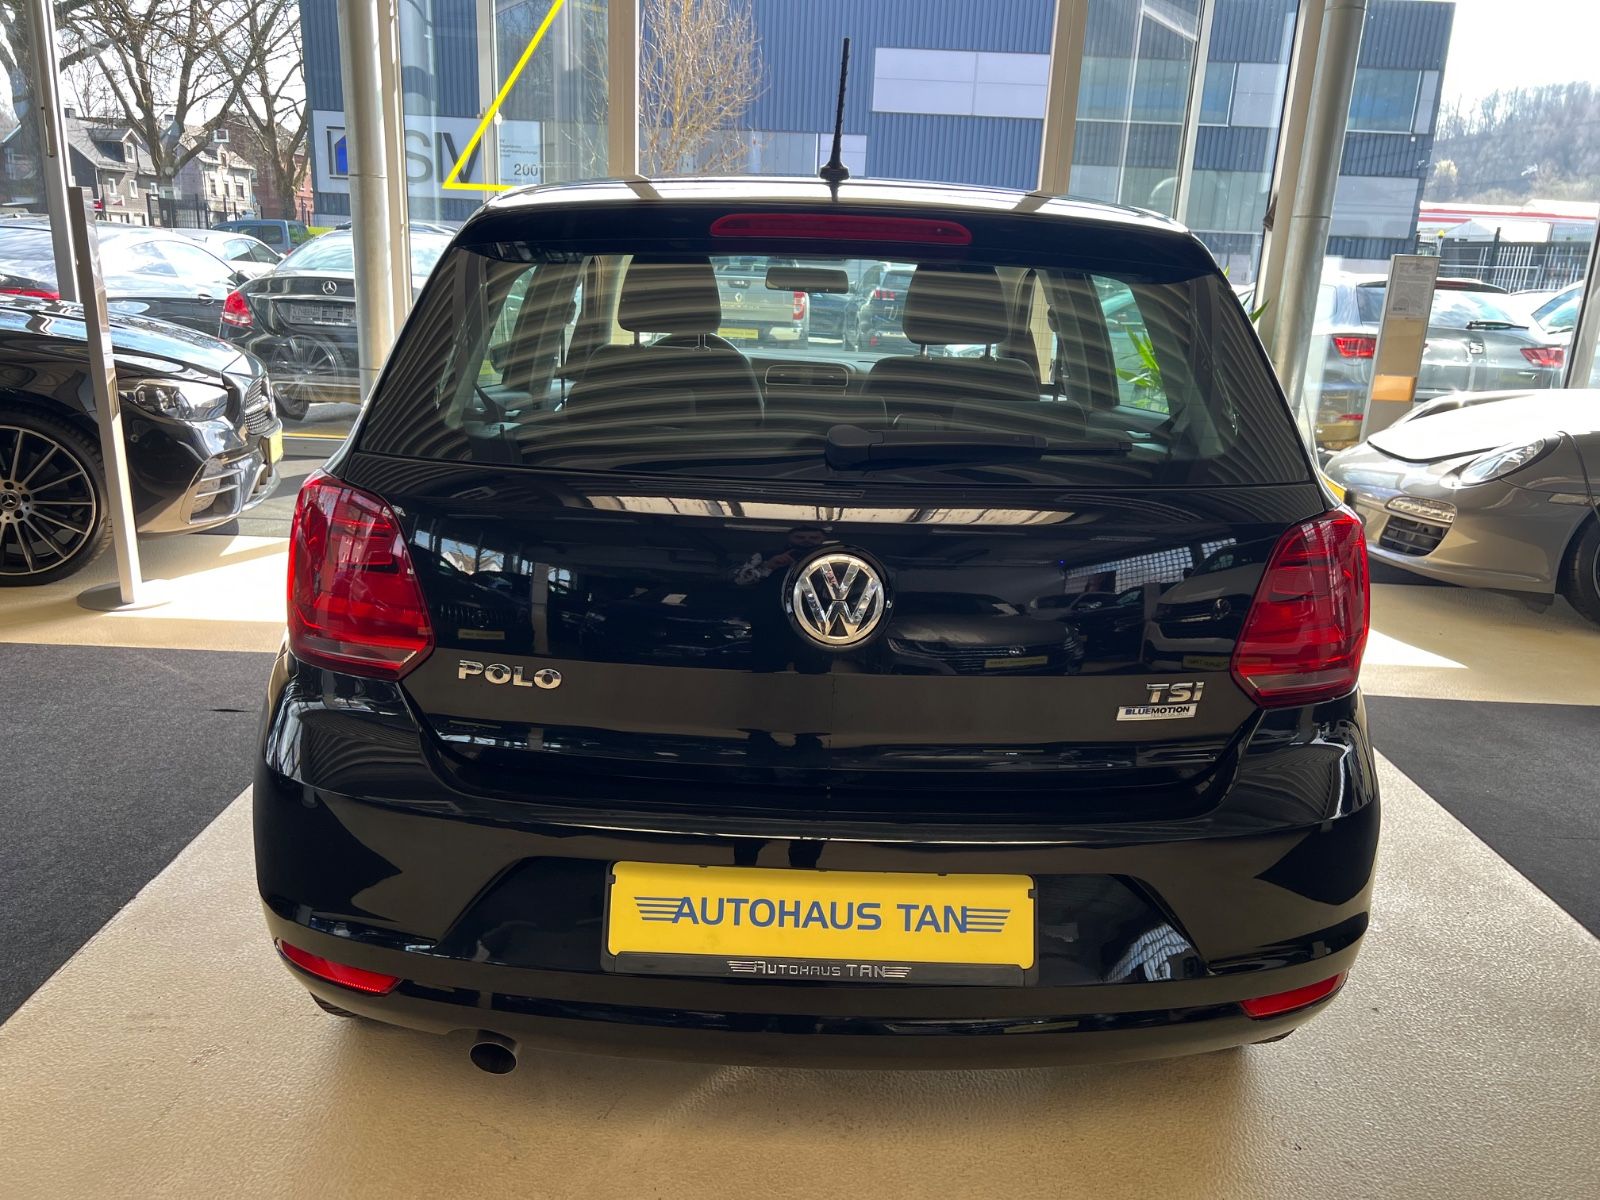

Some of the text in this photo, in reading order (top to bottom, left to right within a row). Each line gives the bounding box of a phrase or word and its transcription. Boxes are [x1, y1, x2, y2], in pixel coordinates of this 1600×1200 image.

[457, 659, 563, 690] POLO
[1125, 706, 1190, 715] BLUEMOTION
[672, 896, 967, 934] AUTOHAUS TAN
[754, 961, 886, 978] AUTOHAUS TAN
